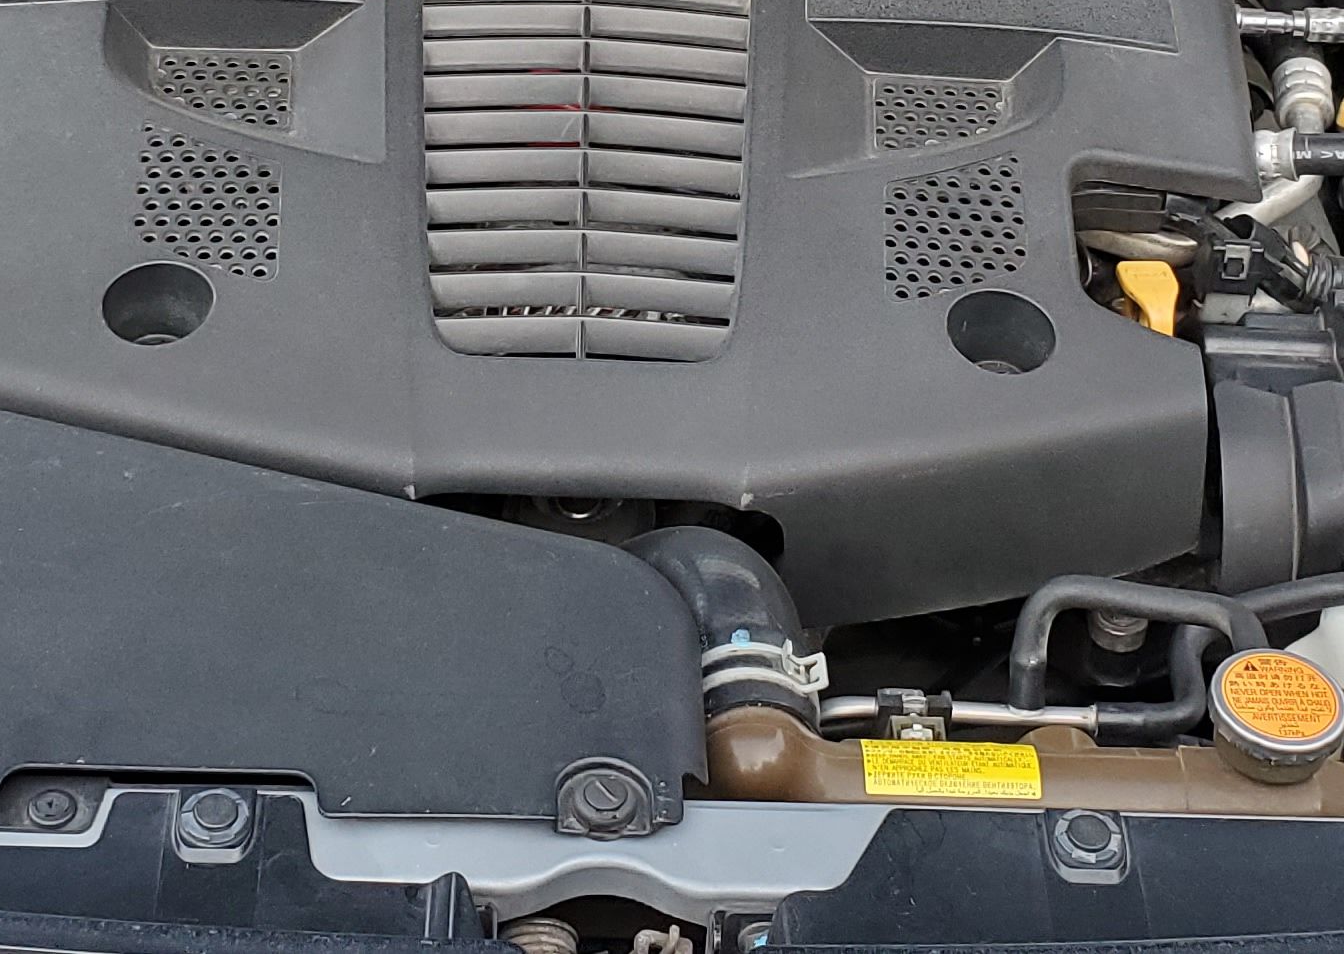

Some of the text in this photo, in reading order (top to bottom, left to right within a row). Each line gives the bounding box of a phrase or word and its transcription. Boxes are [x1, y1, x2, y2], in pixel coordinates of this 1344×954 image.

[1230, 687, 1257, 696] NEVER
[1259, 688, 1282, 697] OPEN
[1284, 689, 1310, 698] WHEN
[1252, 711, 1321, 723] AVERTISSEMENT
